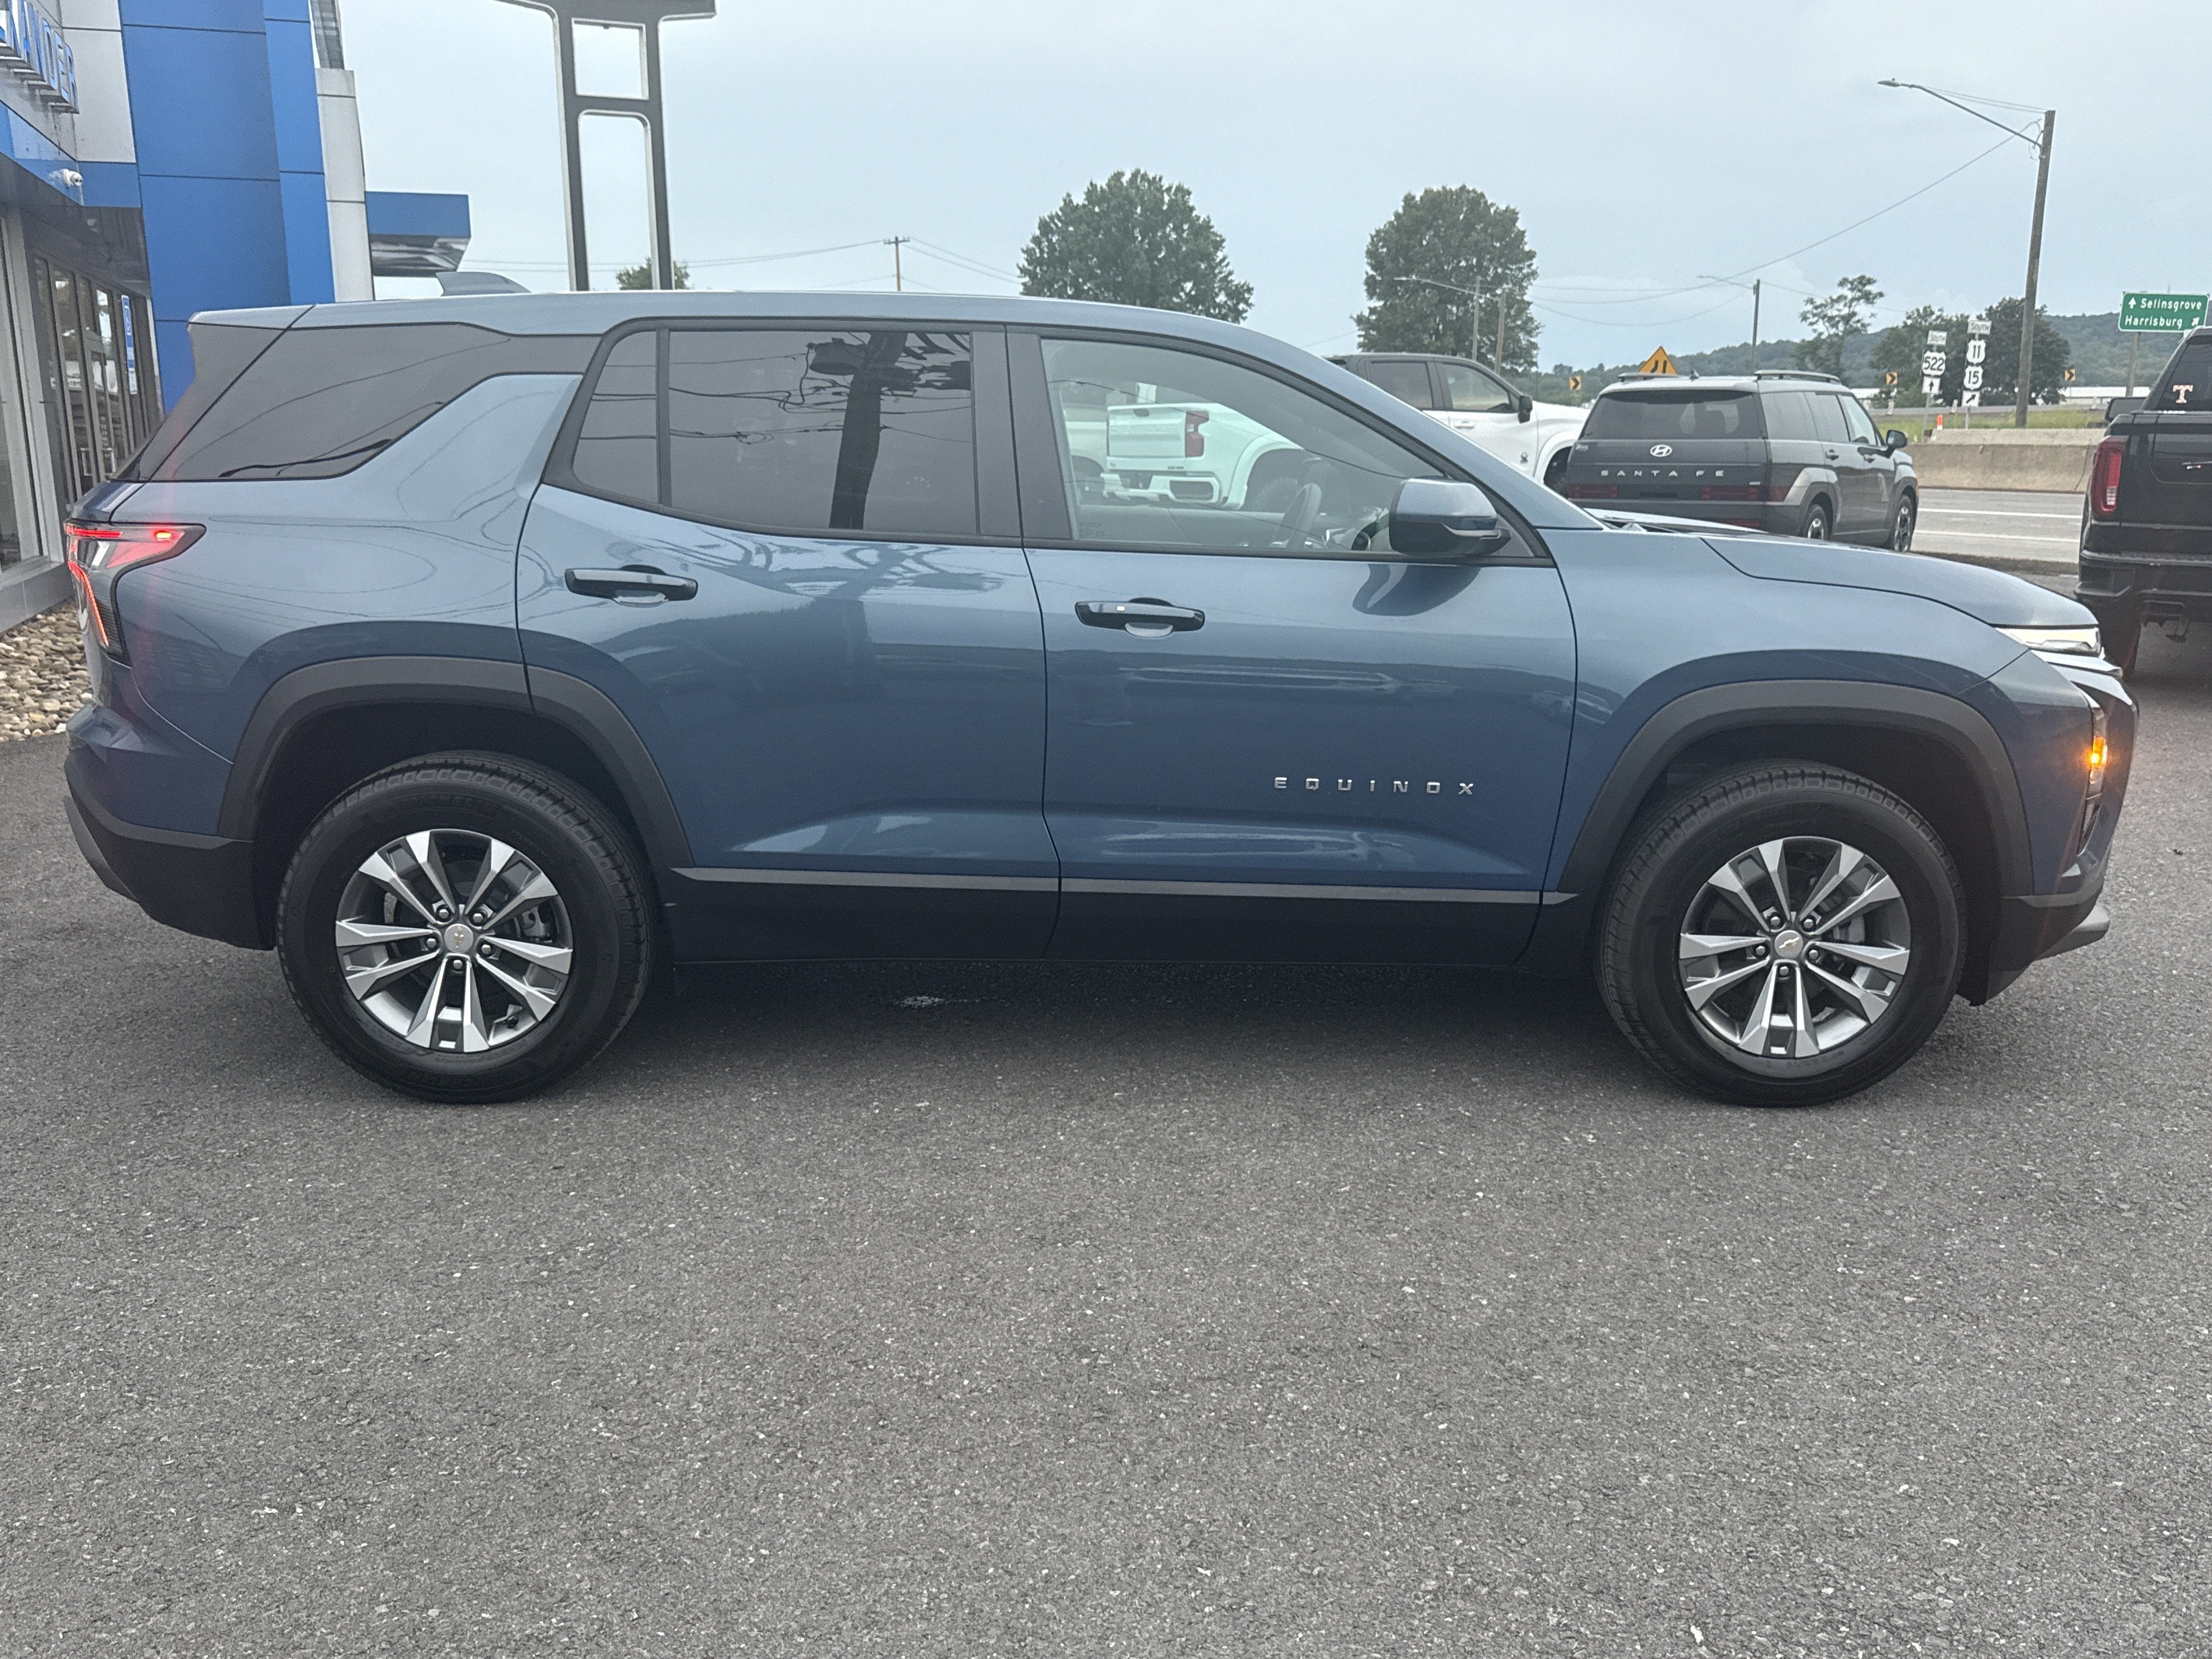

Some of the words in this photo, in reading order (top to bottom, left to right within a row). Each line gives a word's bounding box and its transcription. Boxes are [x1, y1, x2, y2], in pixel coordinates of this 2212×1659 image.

[2140, 298, 2202, 312] Selinsgrove
[1970, 323, 1989, 331] SOUTH
[2124, 315, 2183, 329] Harrisburg
[1973, 345, 1981, 358] 11
[1923, 356, 1944, 371] 522
[1968, 370, 1979, 384] 15
[2172, 385, 2193, 404] T
[1274, 777, 1474, 795] EQUINOX
